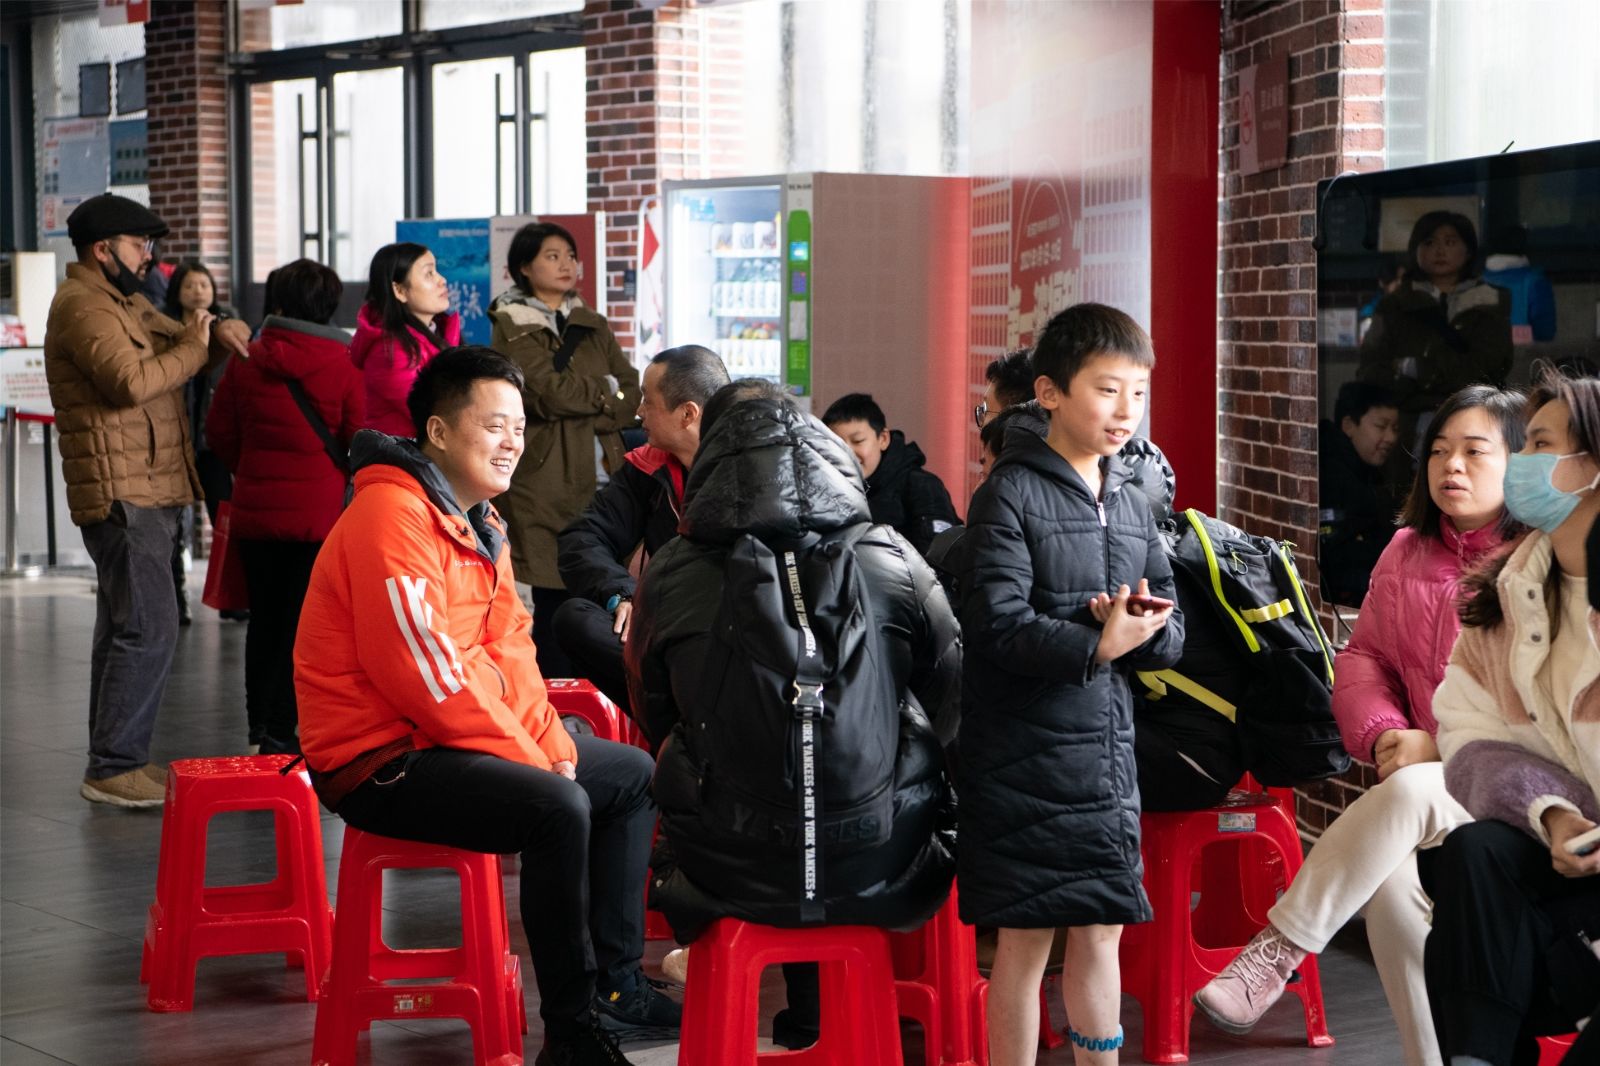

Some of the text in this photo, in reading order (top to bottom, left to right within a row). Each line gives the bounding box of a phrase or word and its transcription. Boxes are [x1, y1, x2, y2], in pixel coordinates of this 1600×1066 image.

[785, 552, 796, 565] ORK
[787, 566, 801, 595] YANKEES
[803, 744, 814, 787] YANKEES
[804, 796, 815, 818] NEW
[805, 820, 815, 846] YORK
[805, 847, 816, 890] YANKEES
